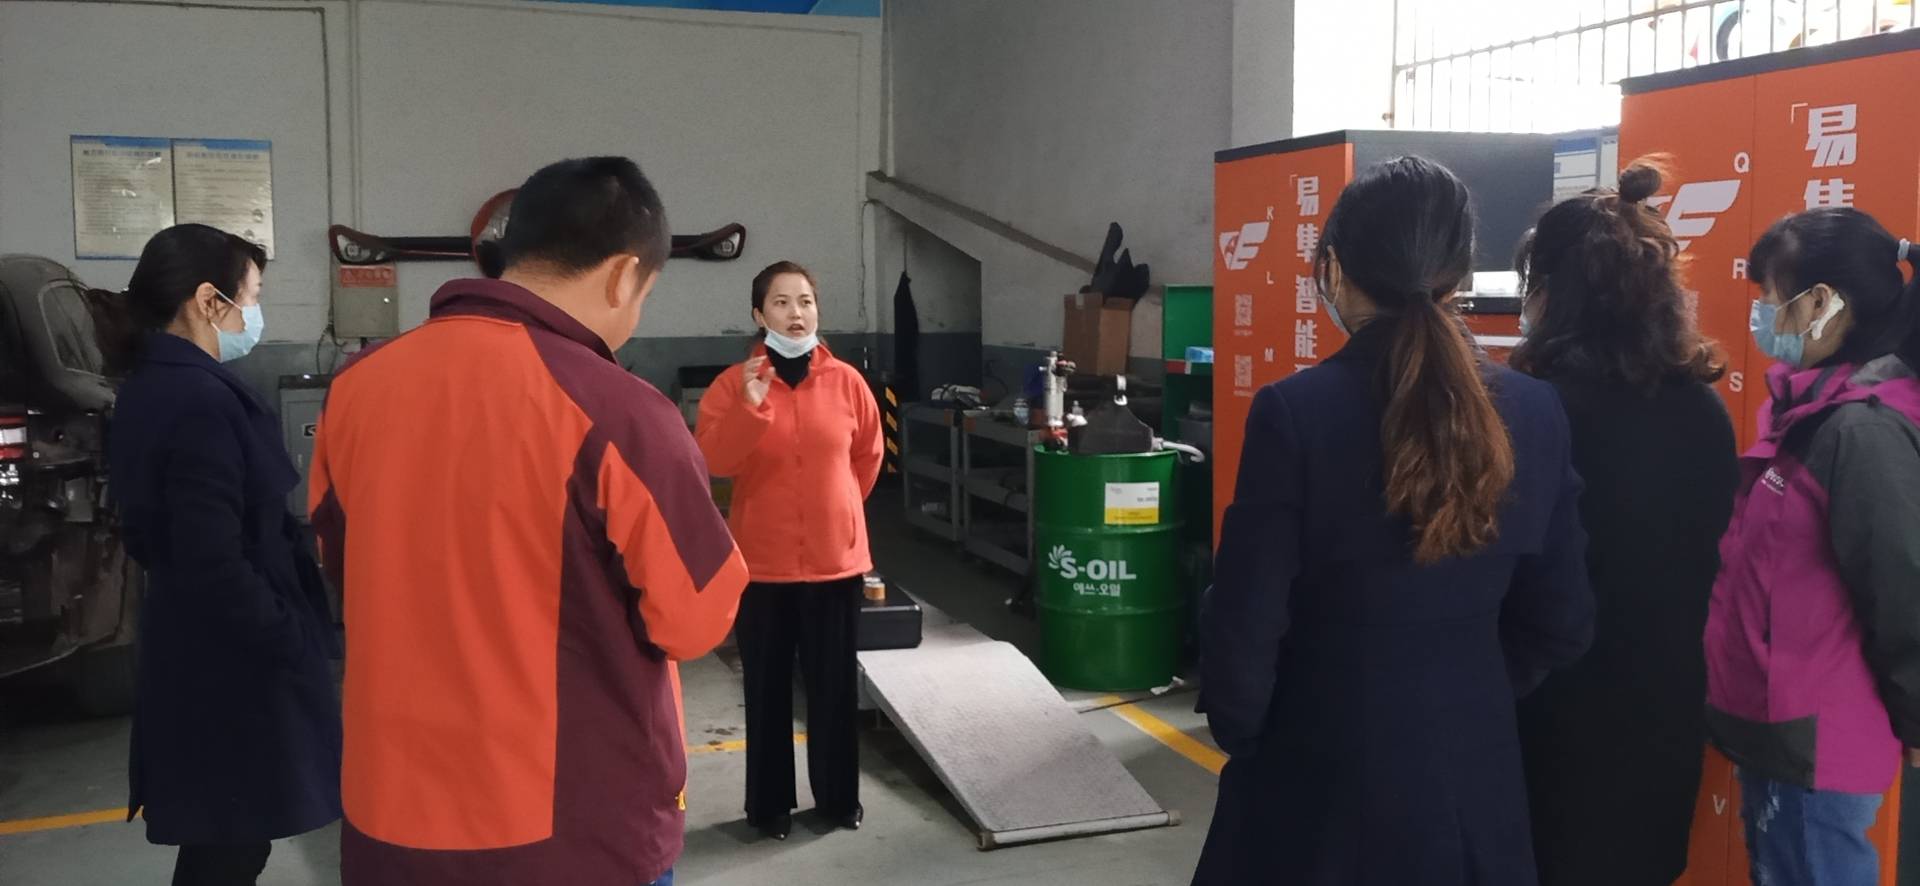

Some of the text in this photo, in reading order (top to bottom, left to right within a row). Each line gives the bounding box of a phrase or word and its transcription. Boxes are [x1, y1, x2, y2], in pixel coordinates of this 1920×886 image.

[1733, 152, 1750, 173] Q
[1266, 206, 1274, 221] K
[1266, 271, 1274, 285] L
[1294, 175, 1320, 373] 易集智能
[1732, 258, 1747, 279] R
[1264, 347, 1274, 363] M
[1728, 371, 1744, 391] S
[1060, 557, 1137, 580] S-OIL
[1712, 794, 1726, 815] V
